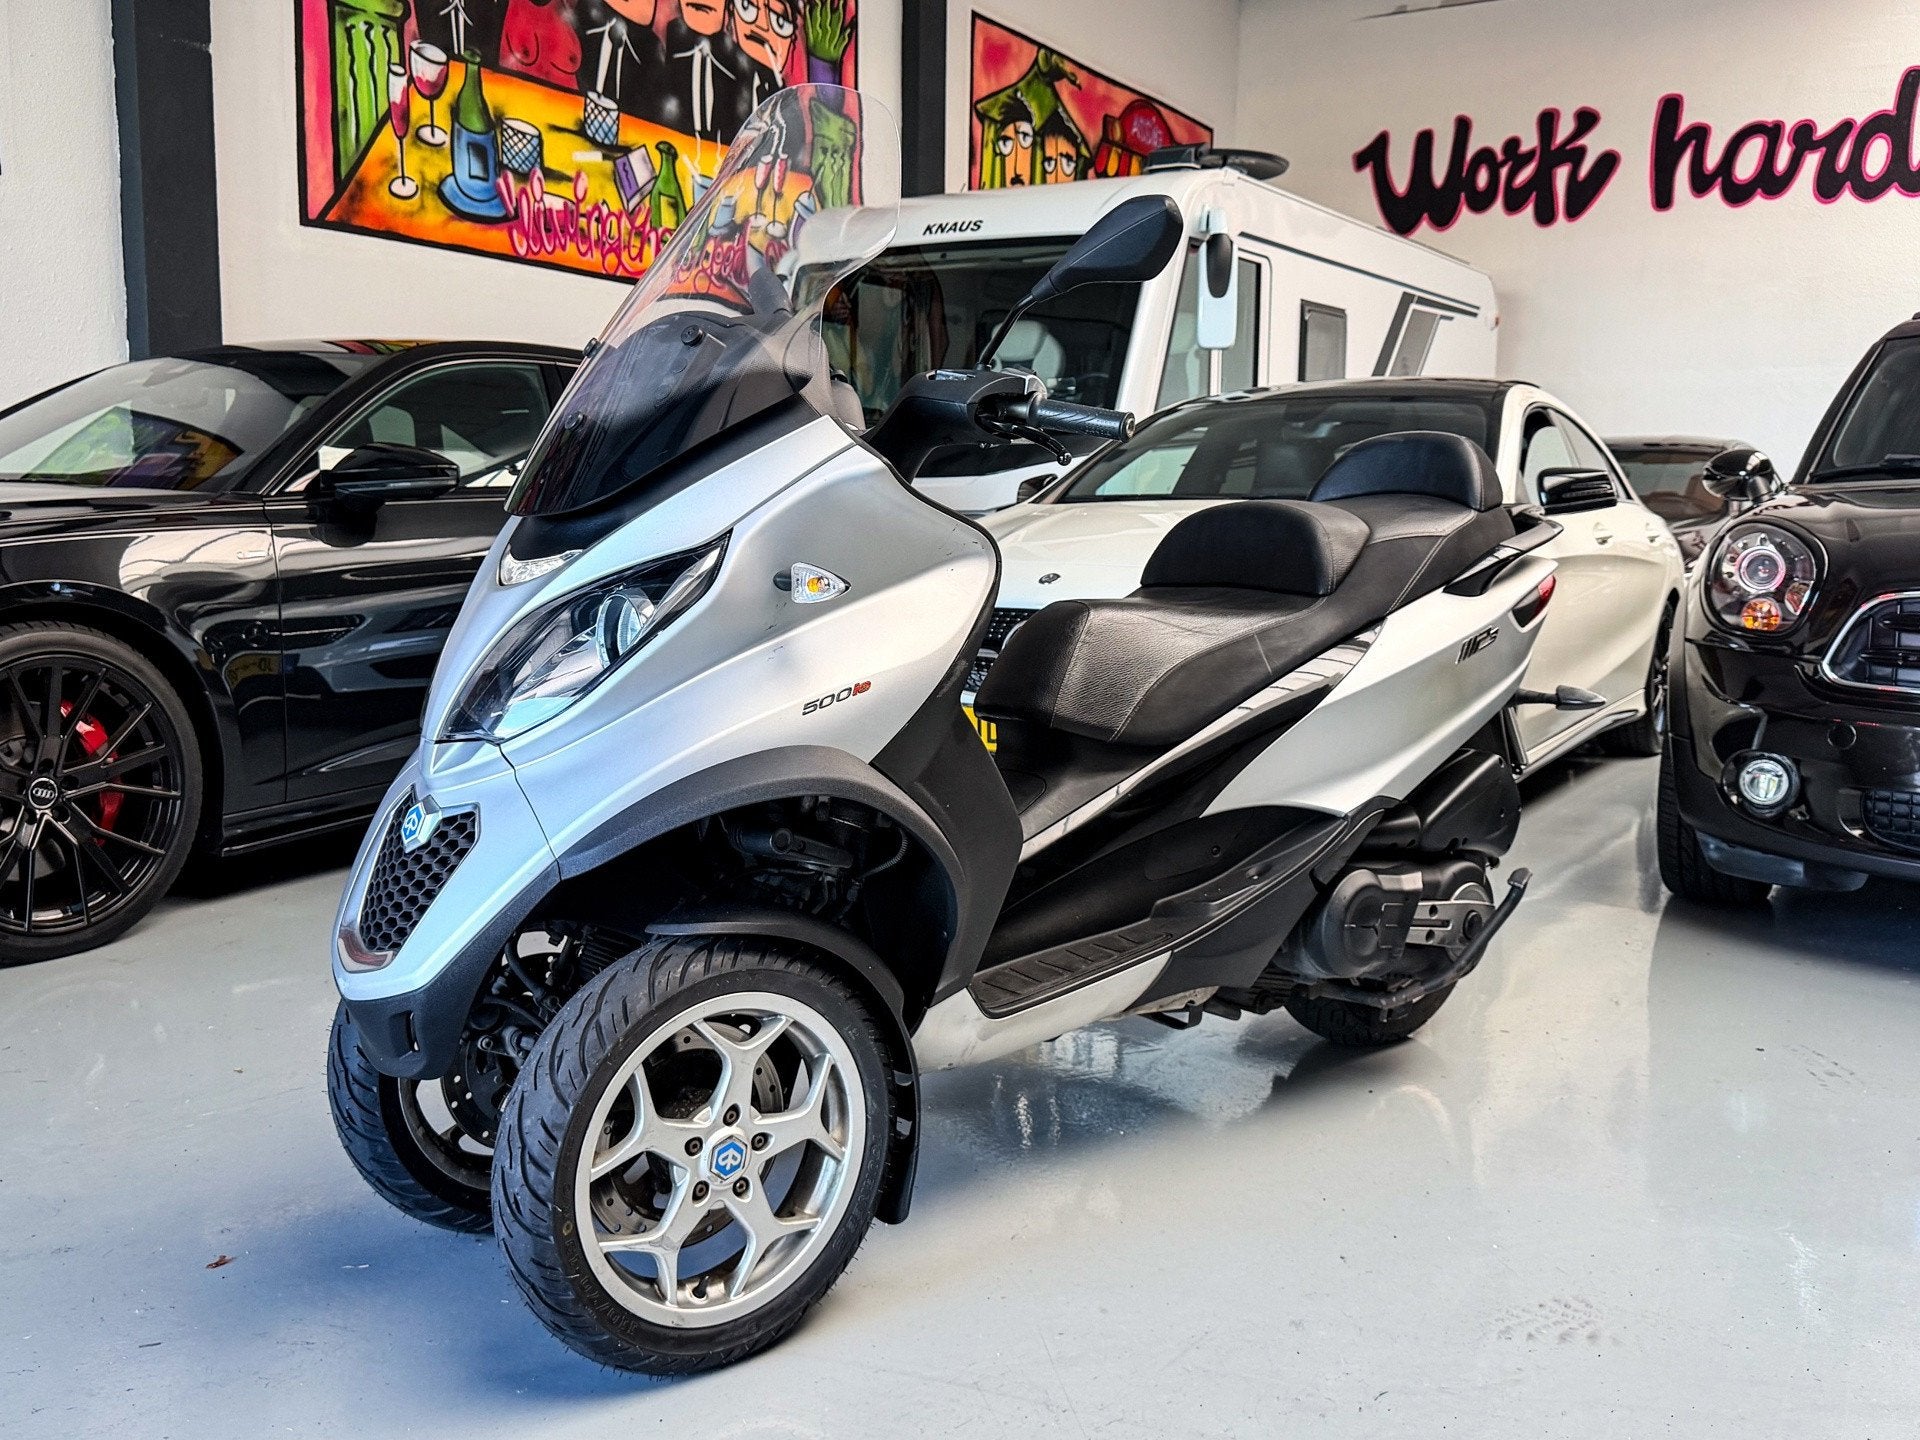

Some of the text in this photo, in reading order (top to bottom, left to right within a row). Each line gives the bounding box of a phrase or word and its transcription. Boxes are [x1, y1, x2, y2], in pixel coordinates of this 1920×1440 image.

[1352, 66, 1920, 238] Work hard
[922, 219, 984, 236] KNAUS
